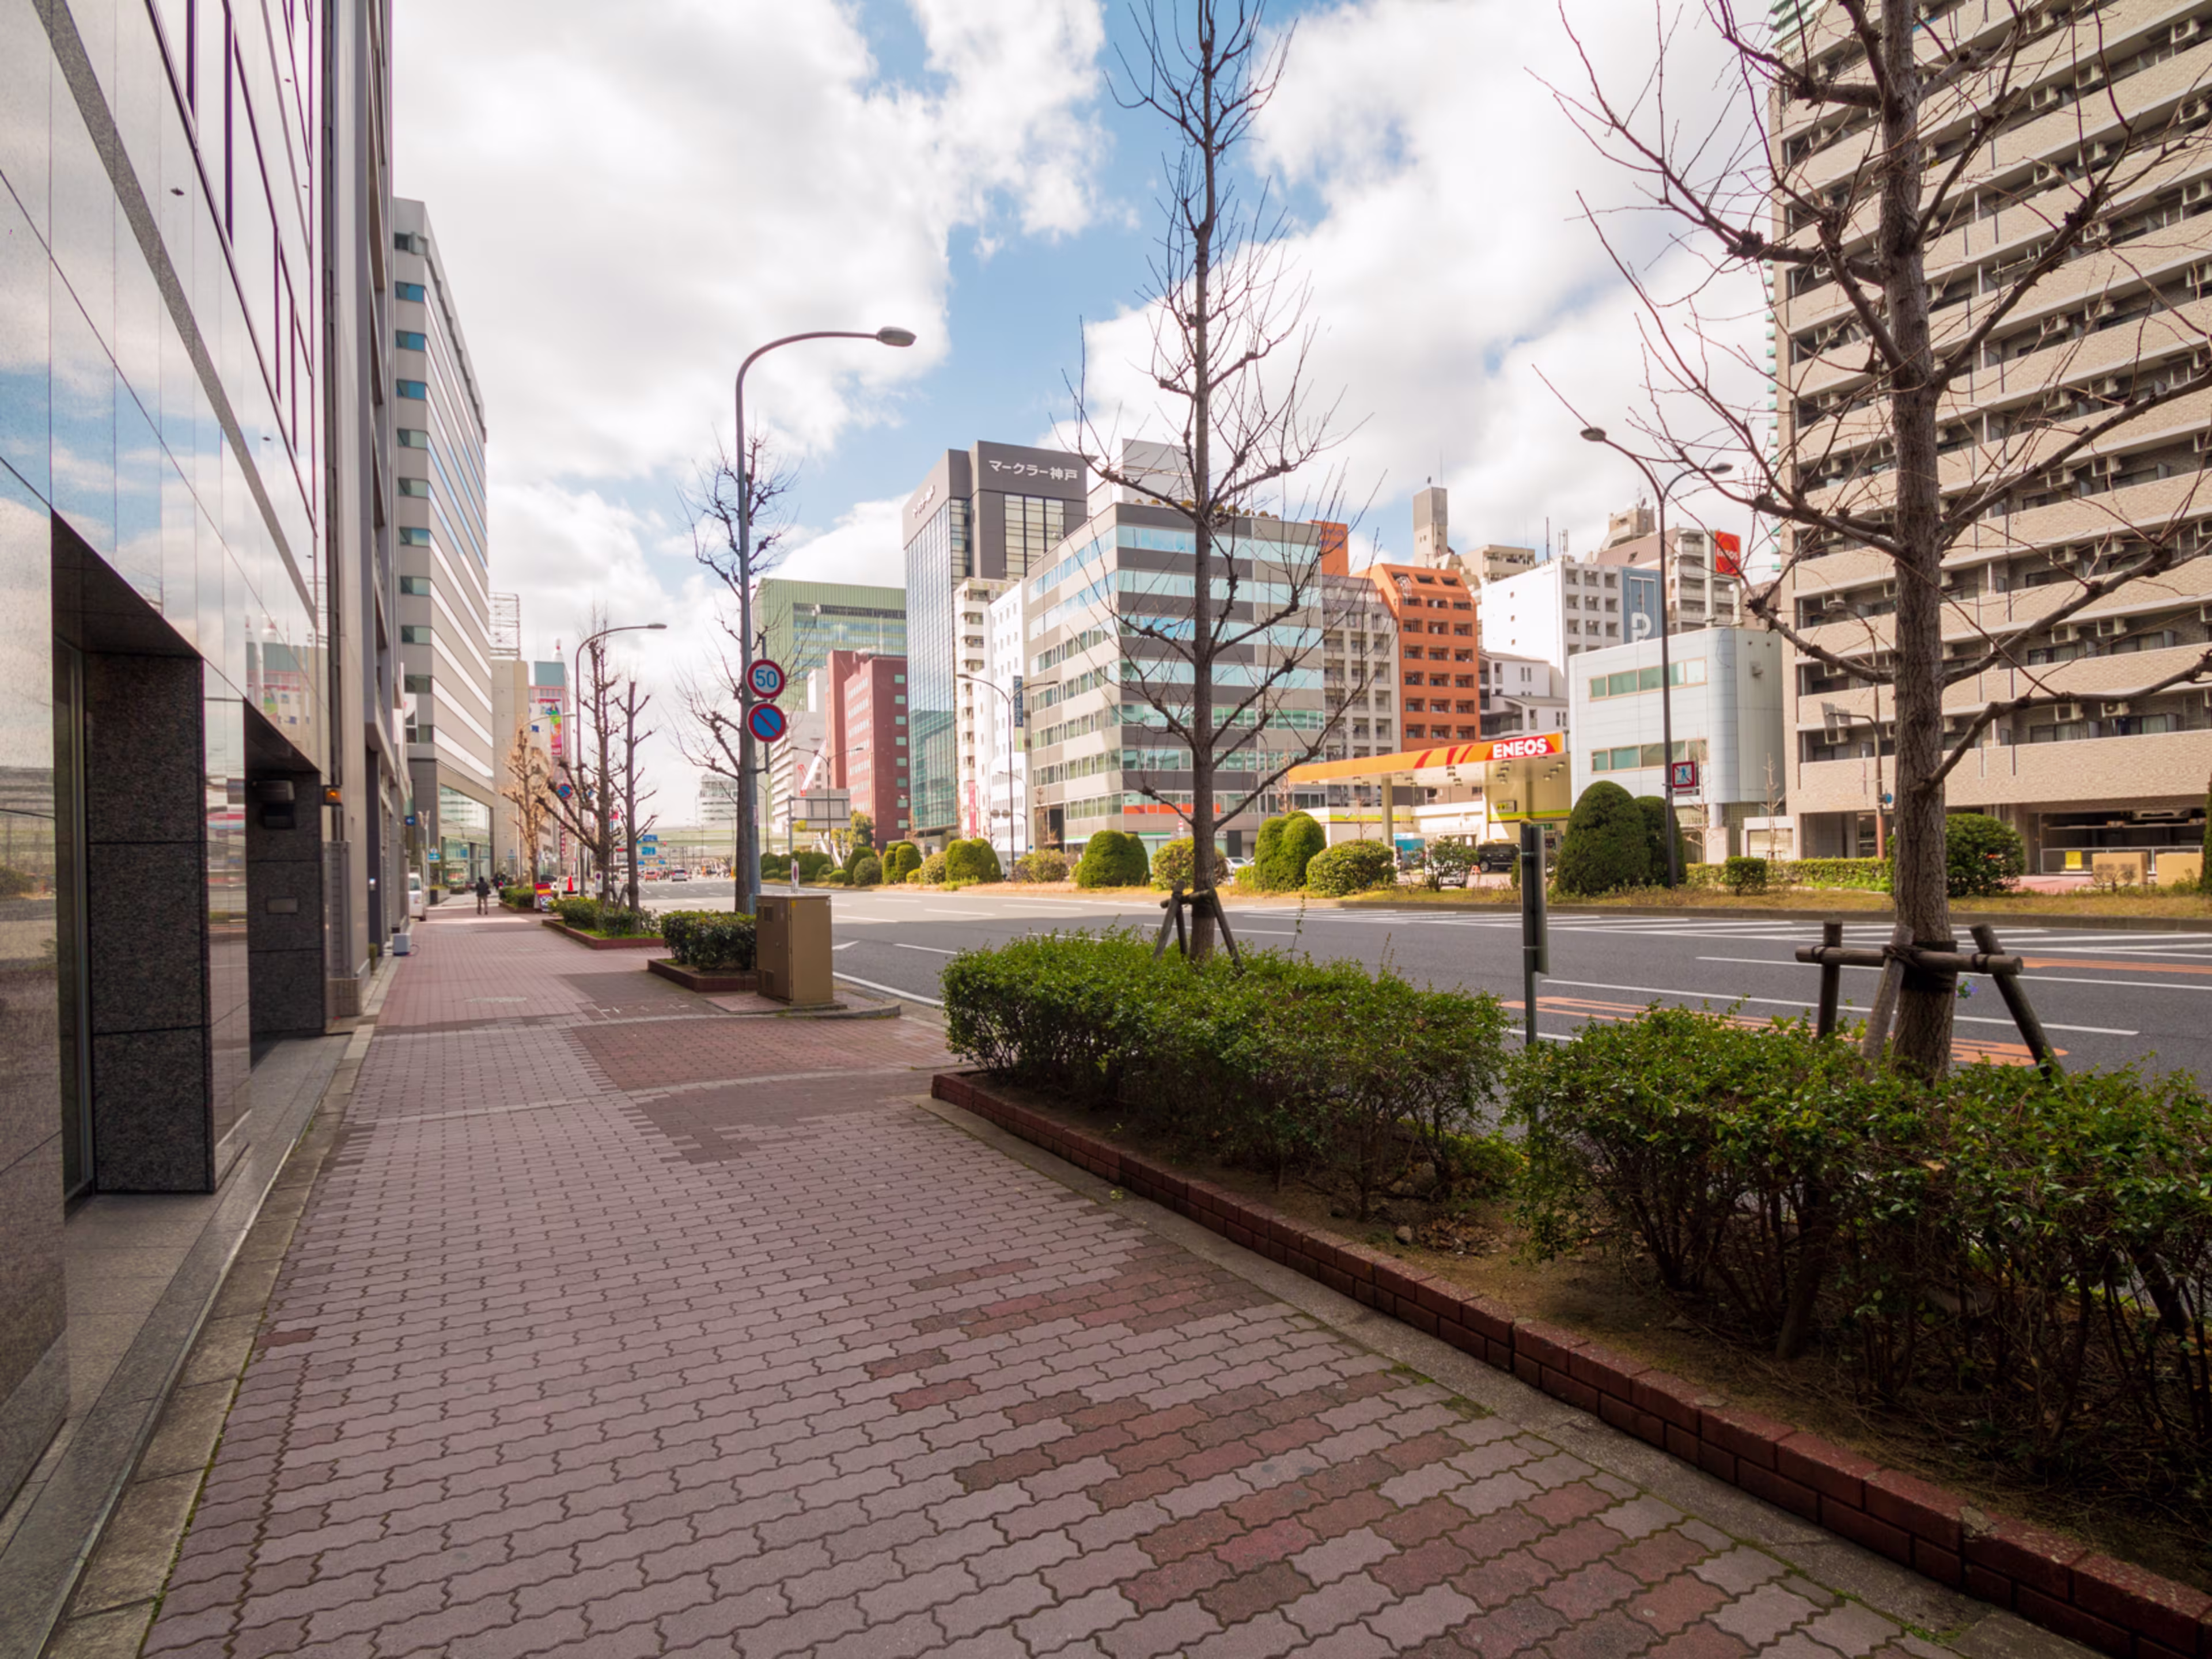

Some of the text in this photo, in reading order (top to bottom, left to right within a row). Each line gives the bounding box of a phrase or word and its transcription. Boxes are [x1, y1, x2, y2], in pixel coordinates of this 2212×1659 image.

[988, 460, 1078, 480] マークラー神戸
[755, 669, 777, 688] 50
[1493, 737, 1547, 759] ENEOS
